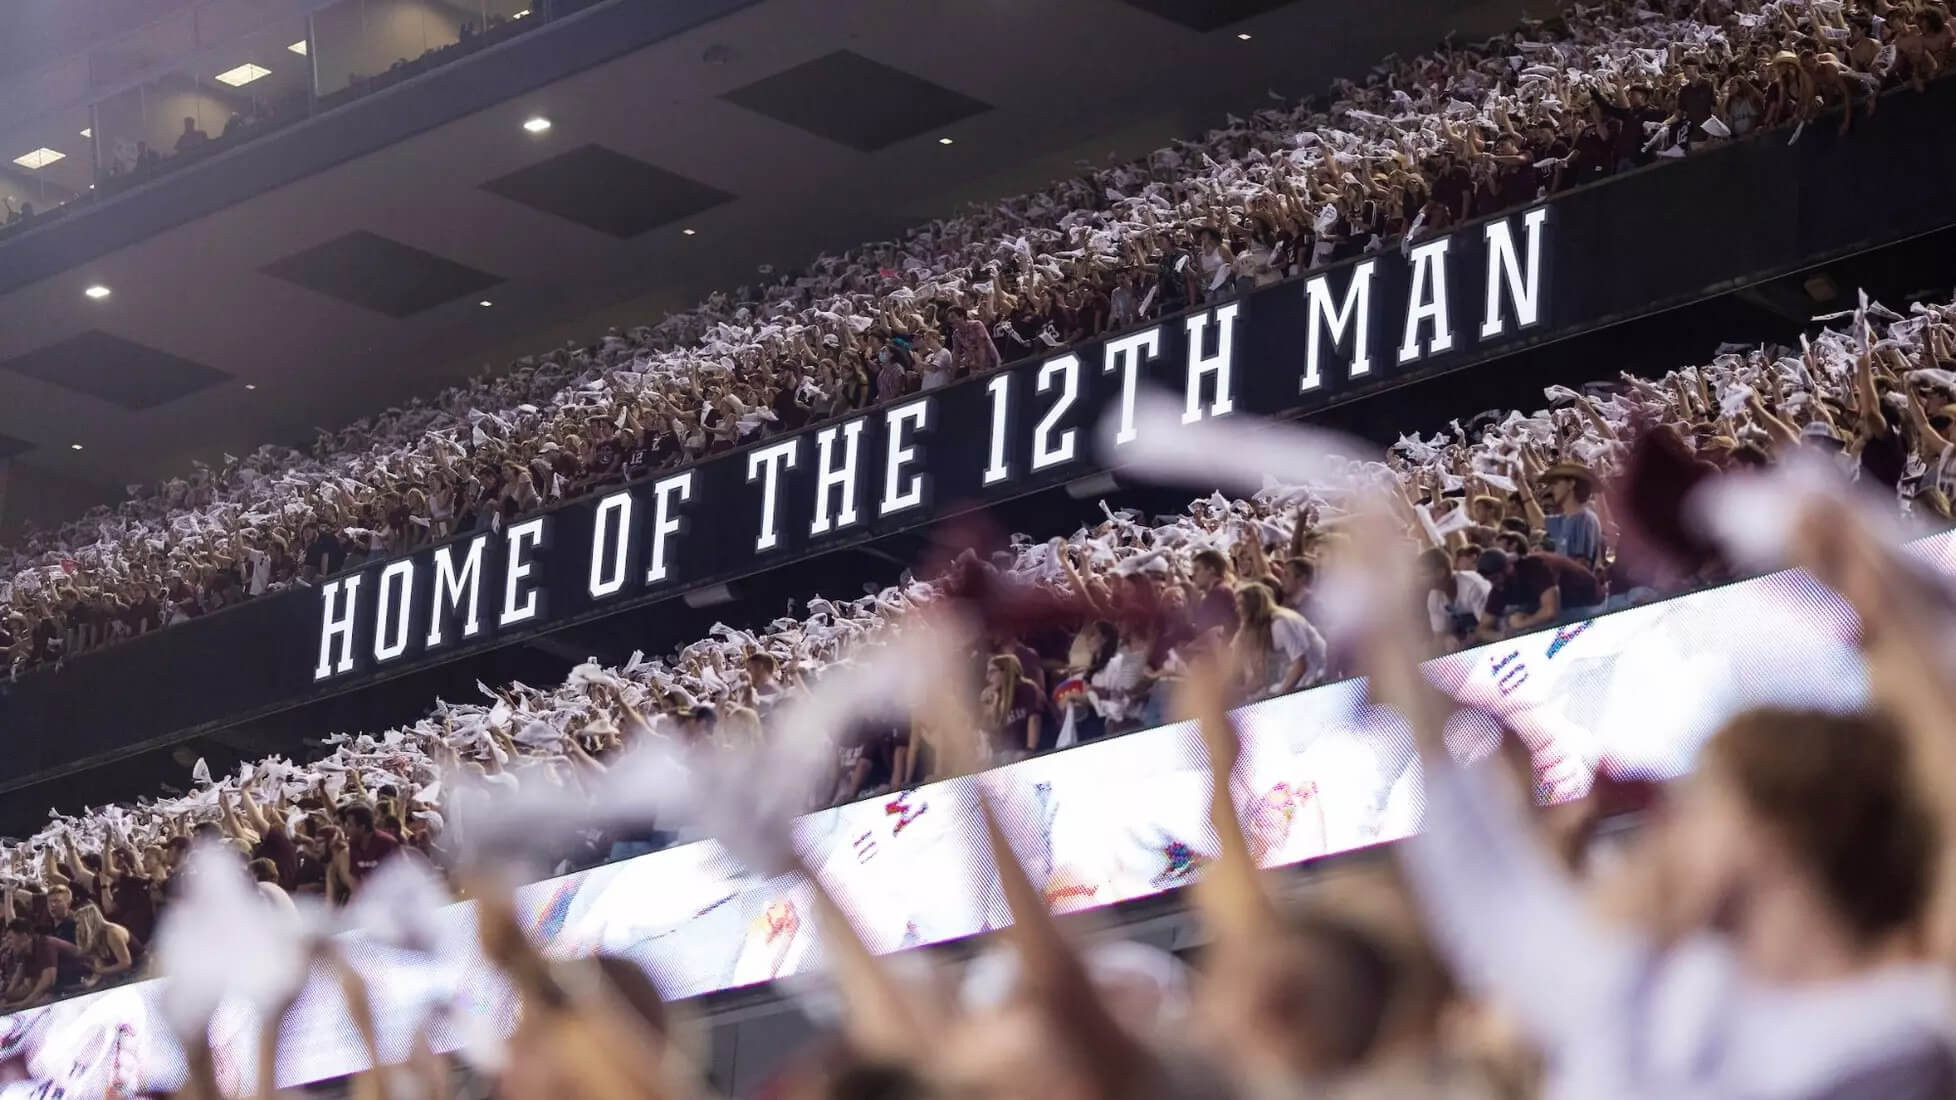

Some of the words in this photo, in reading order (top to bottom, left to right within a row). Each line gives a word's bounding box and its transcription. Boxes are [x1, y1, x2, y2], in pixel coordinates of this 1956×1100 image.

[314, 518, 546, 680] HOME
[590, 472, 694, 597] OF
[748, 400, 930, 550] THE
[984, 304, 1238, 484] 12TH
[1301, 209, 1546, 390] MAN
